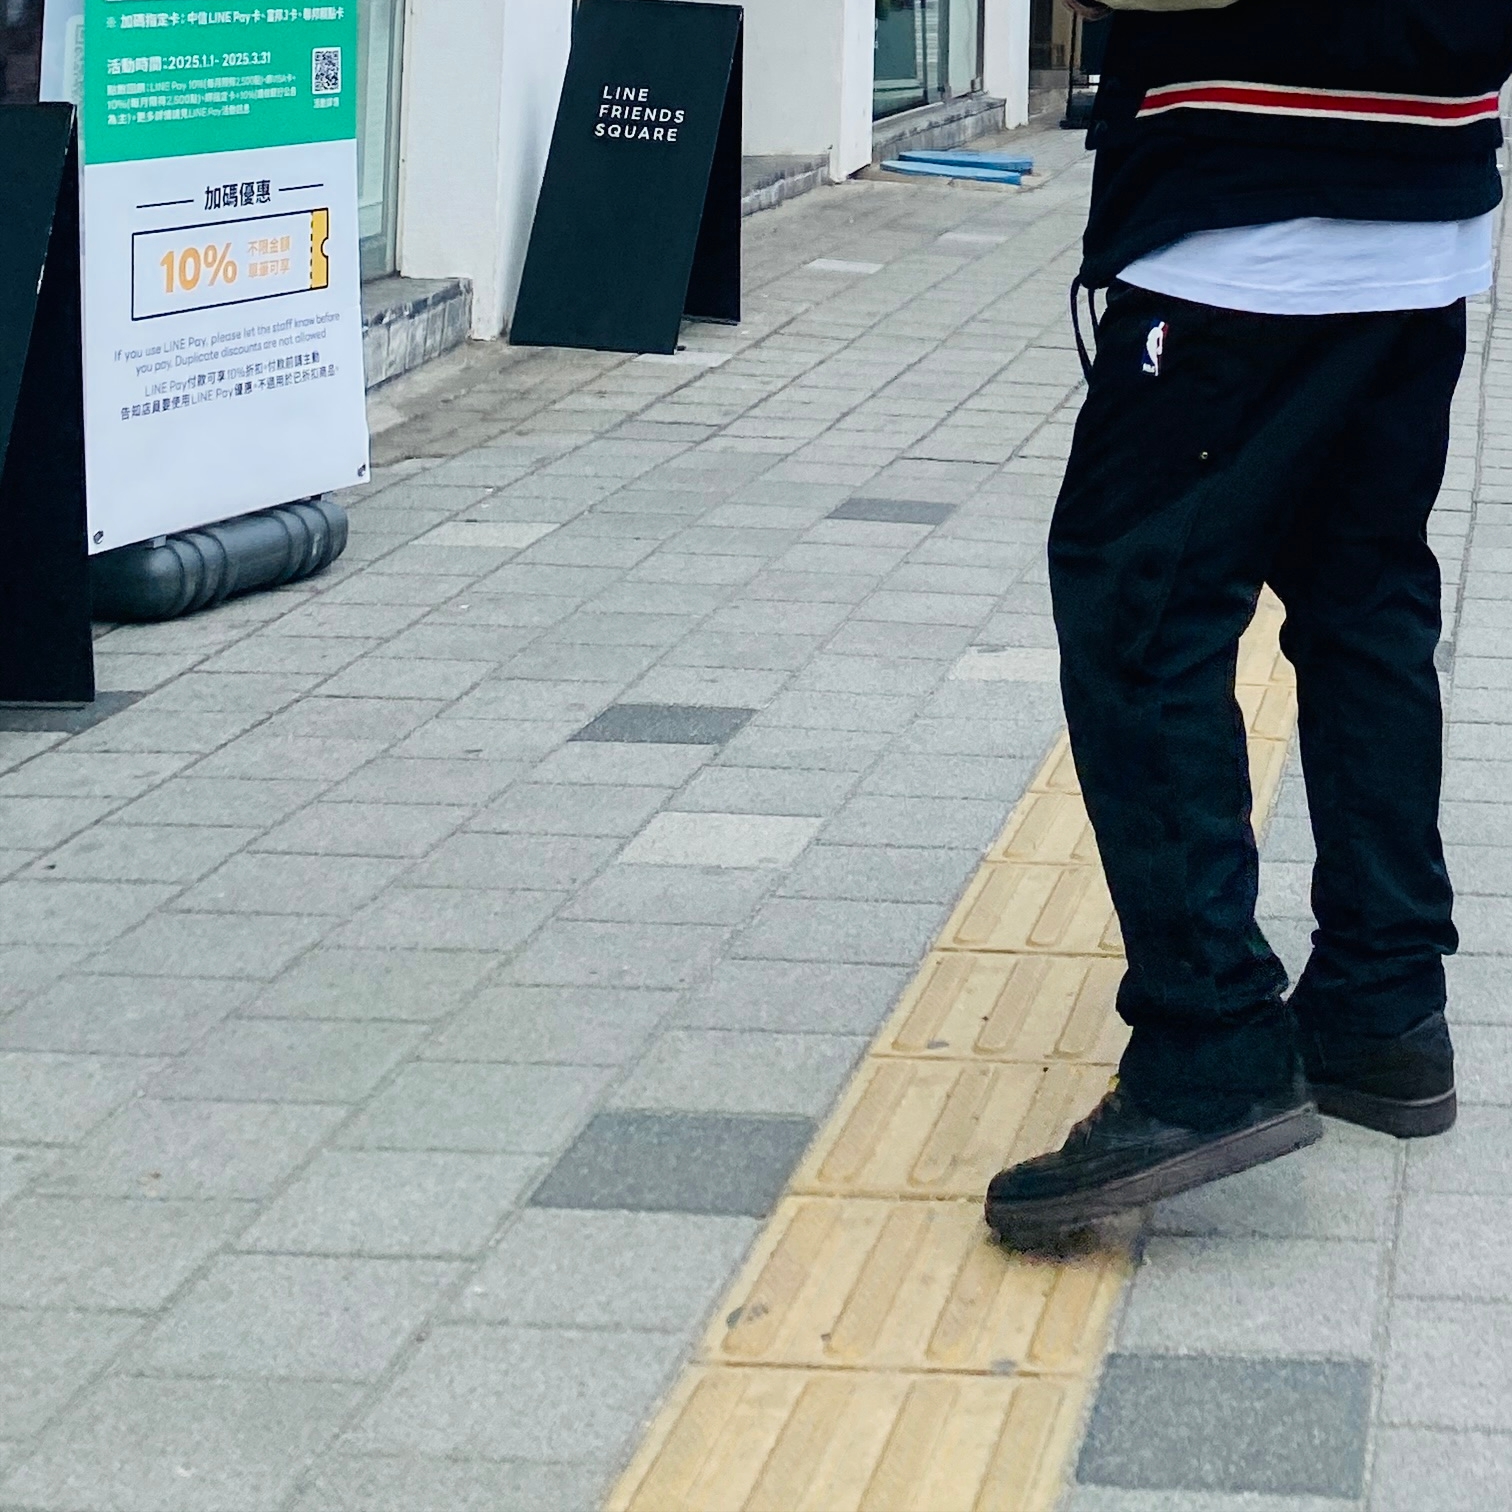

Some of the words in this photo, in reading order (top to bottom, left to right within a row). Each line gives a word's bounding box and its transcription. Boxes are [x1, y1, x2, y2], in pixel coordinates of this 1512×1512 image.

[603, 85, 649, 102] LINE
[599, 104, 685, 124] FRIENDS
[594, 123, 678, 142] SQUARE
[204, 179, 272, 211] 加碼優惠
[247, 236, 292, 257] 不限金額
[160, 242, 238, 294] 10%
[114, 349, 122, 362] If
[124, 350, 142, 363] you
[145, 346, 161, 356] use
[164, 338, 186, 354] LINE
[211, 332, 241, 346] please
[243, 327, 255, 338] let
[257, 324, 271, 335] the
[272, 318, 293, 333] staff
[294, 317, 315, 328] know
[316, 312, 340, 325] before
[135, 364, 153, 377] you
[174, 349, 219, 368] Duplicate
[221, 342, 262, 358] discounts
[263, 339, 277, 349] are
[278, 335, 293, 346] not
[295, 328, 327, 344] allowed
[145, 381, 167, 397] LINE
